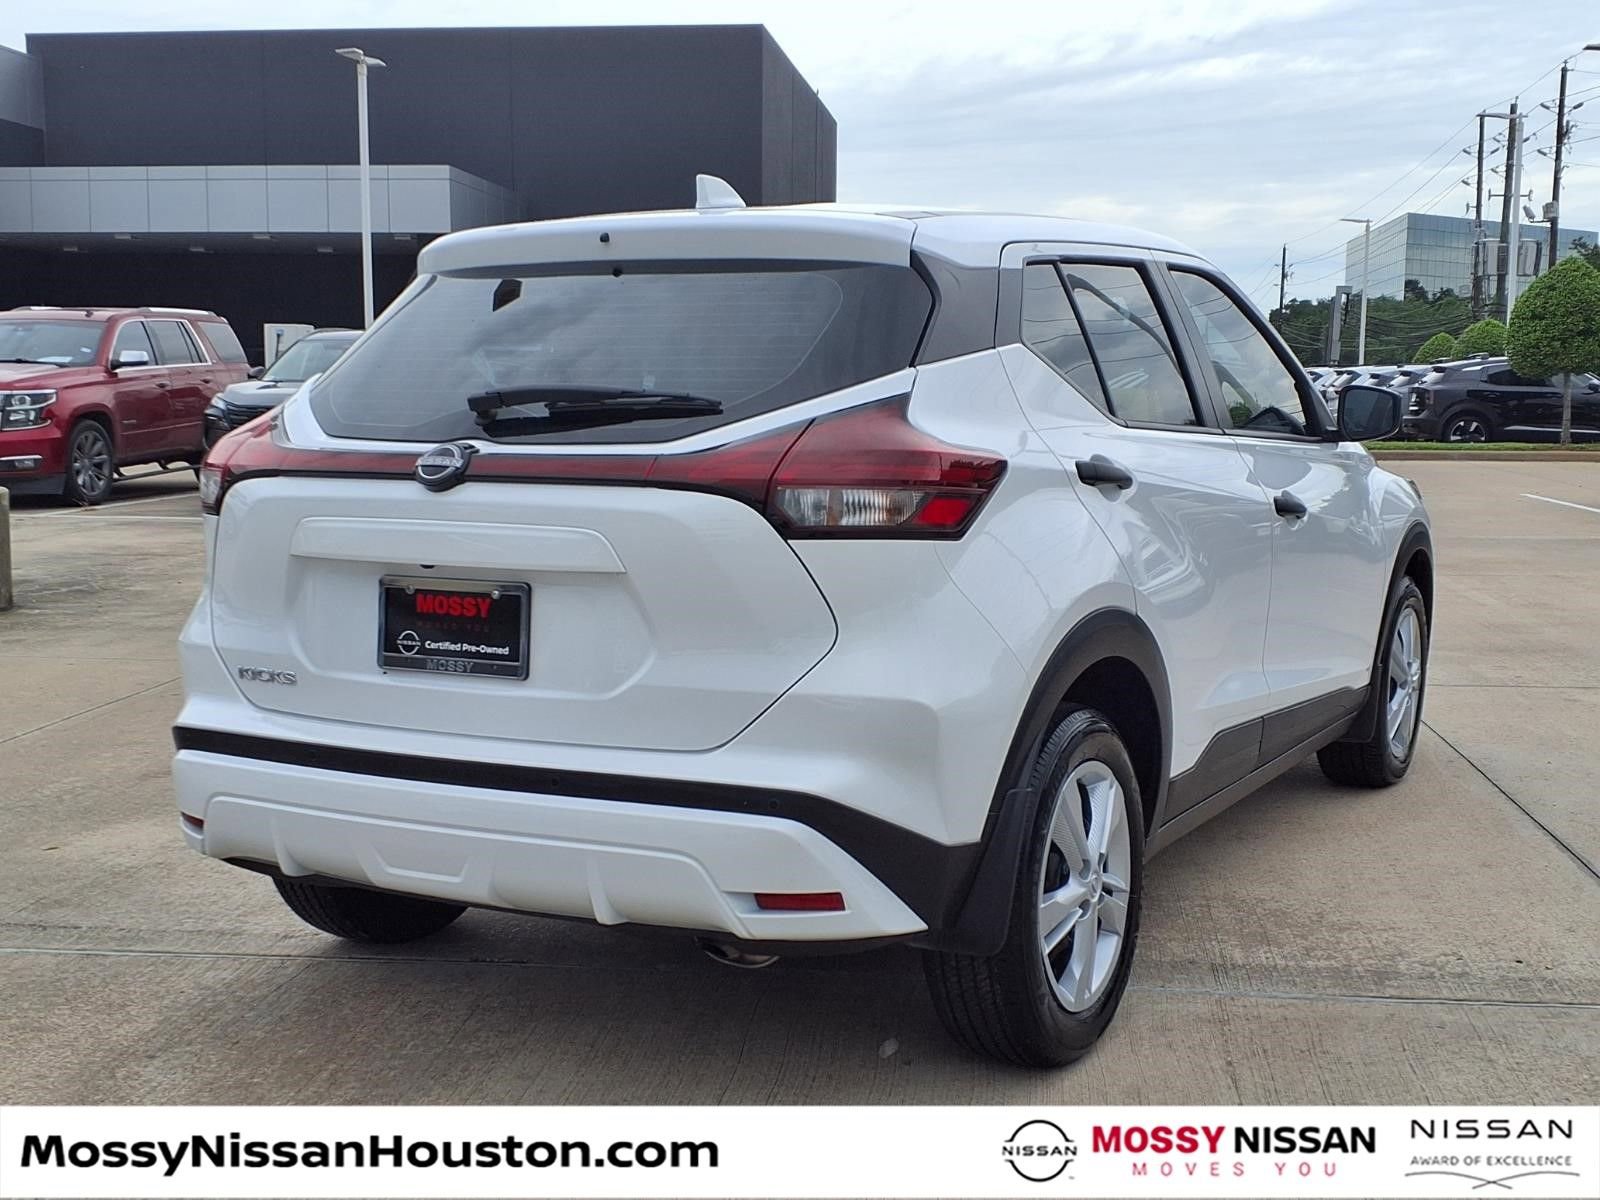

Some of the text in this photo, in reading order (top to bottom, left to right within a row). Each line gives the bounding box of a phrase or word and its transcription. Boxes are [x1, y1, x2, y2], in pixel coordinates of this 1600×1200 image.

[416, 593, 492, 617] MOSSY
[425, 641, 510, 655] Certified Pre-Owned
[426, 659, 474, 673] MOSSY
[238, 667, 297, 686] KICKS
